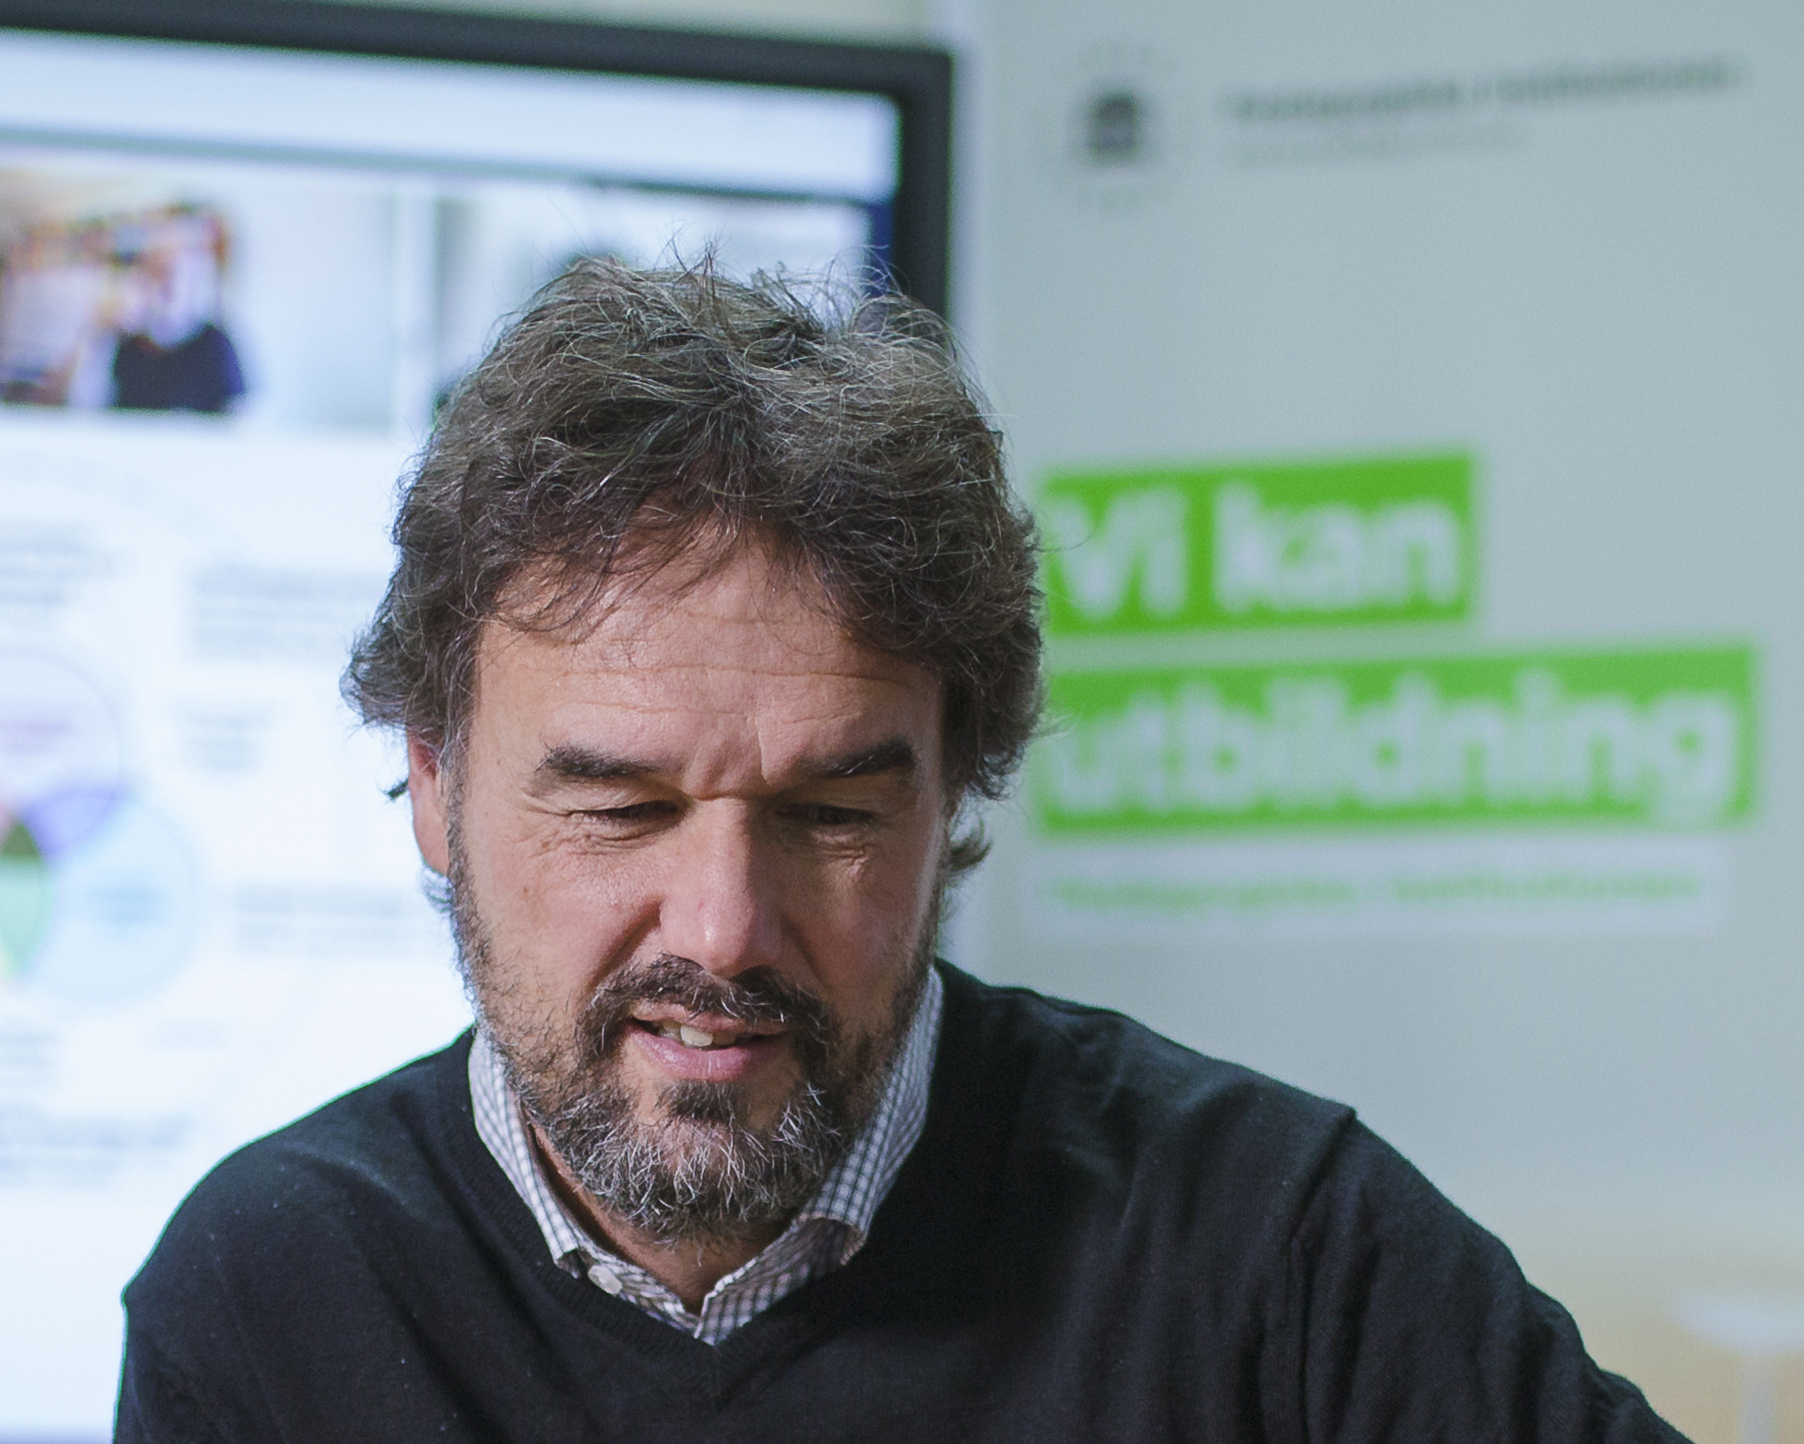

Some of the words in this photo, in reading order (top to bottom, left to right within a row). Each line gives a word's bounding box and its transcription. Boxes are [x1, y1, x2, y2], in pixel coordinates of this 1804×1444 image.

[1043, 490, 1187, 618] Vi
[1211, 480, 1461, 612] kan
[1047, 668, 1737, 828] utbildning
